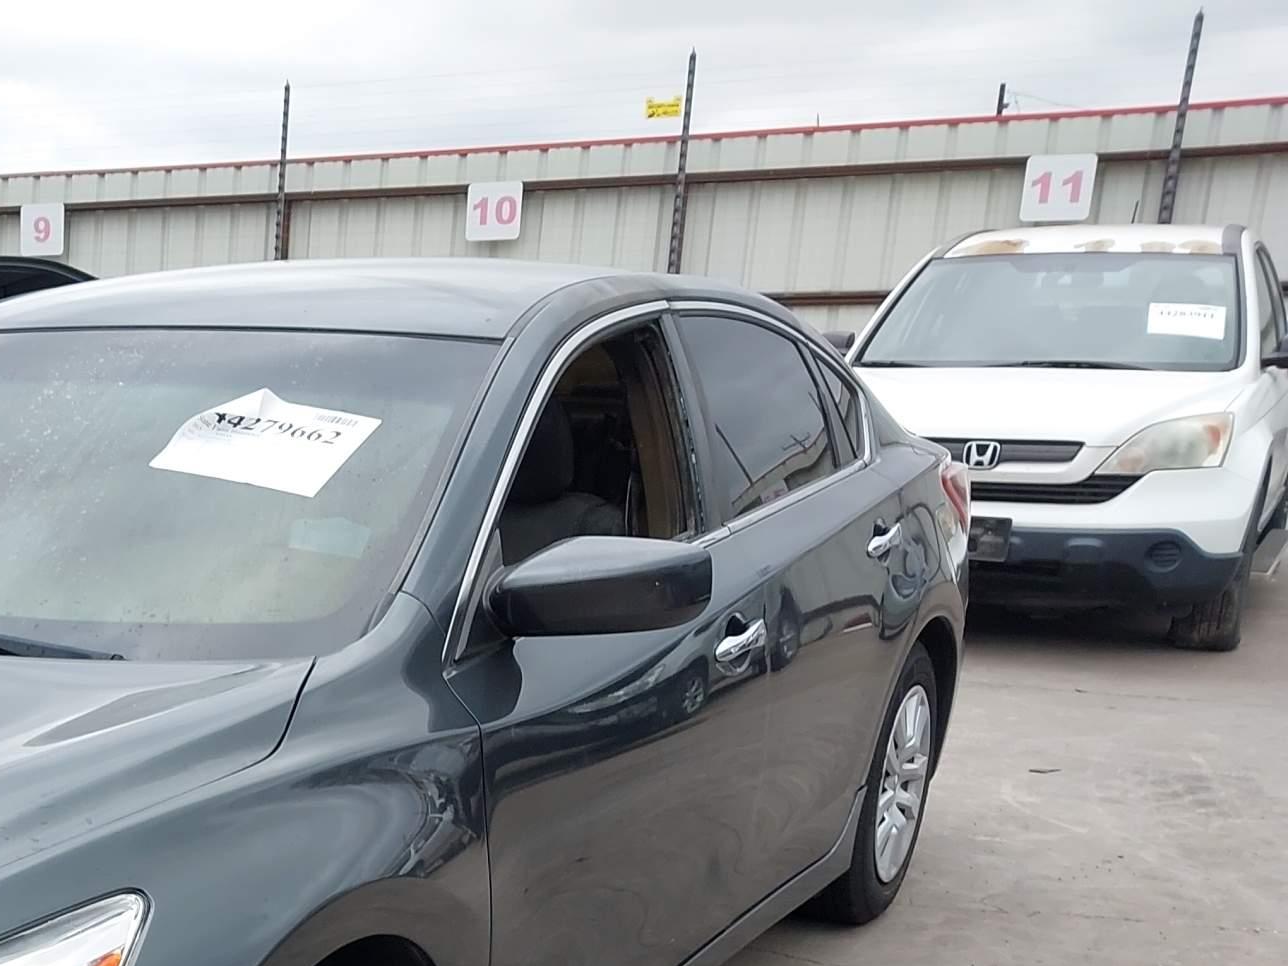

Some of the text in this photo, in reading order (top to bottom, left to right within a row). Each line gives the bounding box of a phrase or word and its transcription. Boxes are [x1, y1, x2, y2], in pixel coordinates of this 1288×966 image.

[1031, 170, 1084, 204] 11
[473, 196, 517, 226] 10
[33, 216, 51, 242] 9
